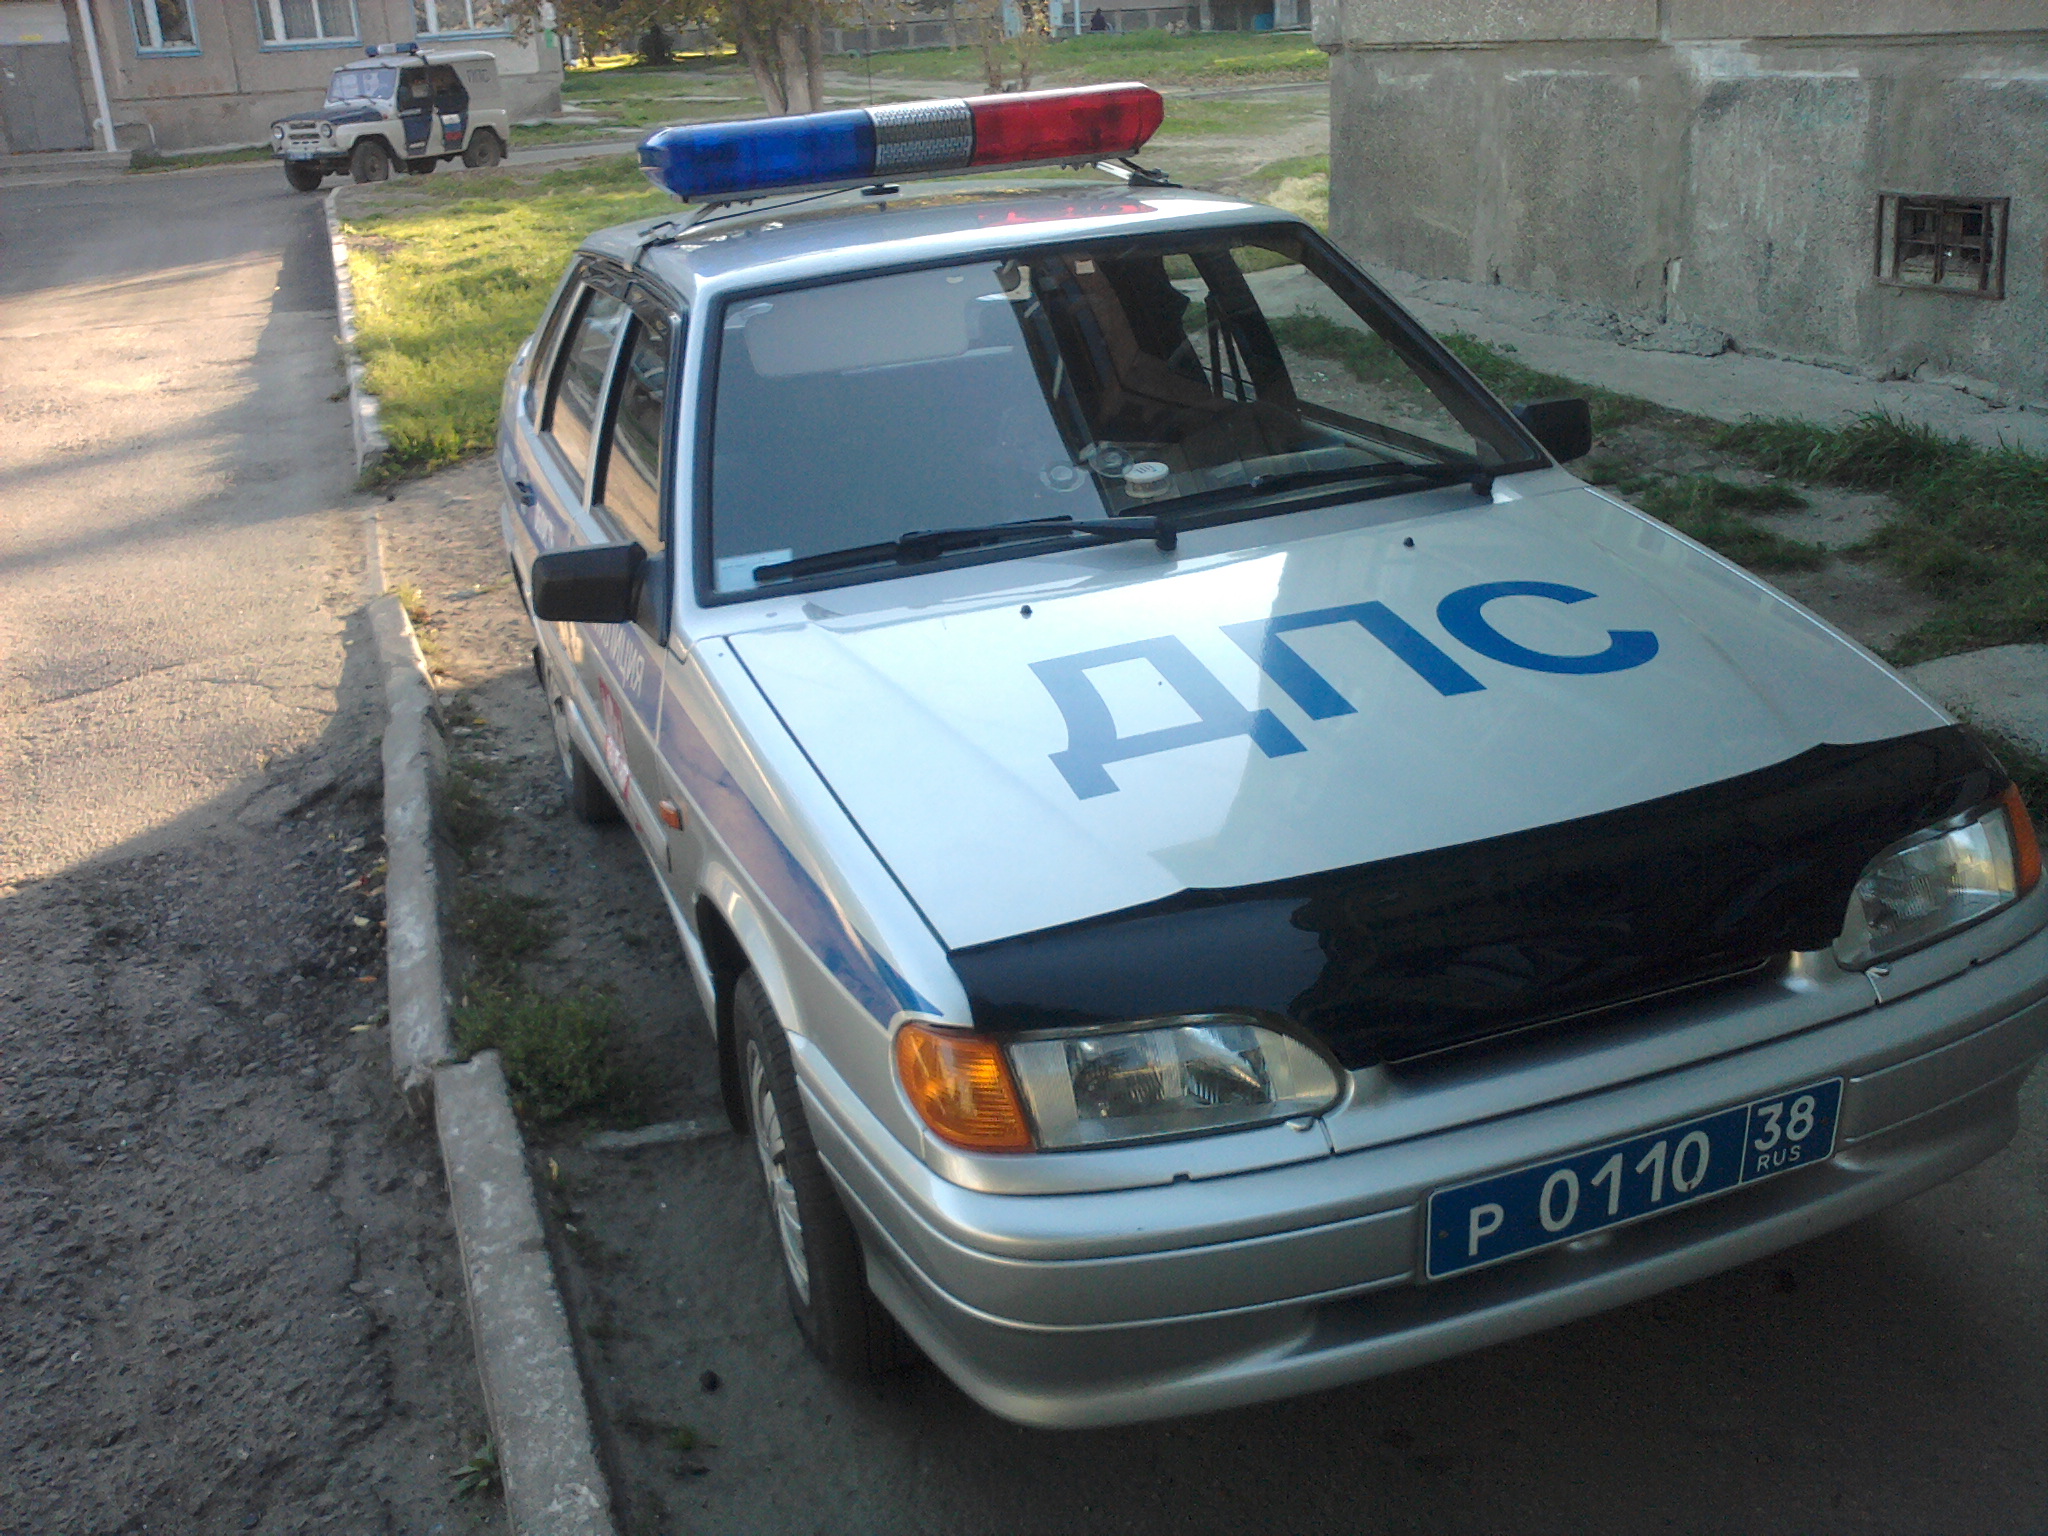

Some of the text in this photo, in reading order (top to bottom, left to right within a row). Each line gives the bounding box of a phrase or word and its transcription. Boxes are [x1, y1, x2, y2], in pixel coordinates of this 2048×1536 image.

[1028, 580, 1659, 800] ДПС
[1539, 1131, 1710, 1232] 0110
[1754, 1095, 1815, 1151] 38
[1757, 1144, 1802, 1172] RUS
